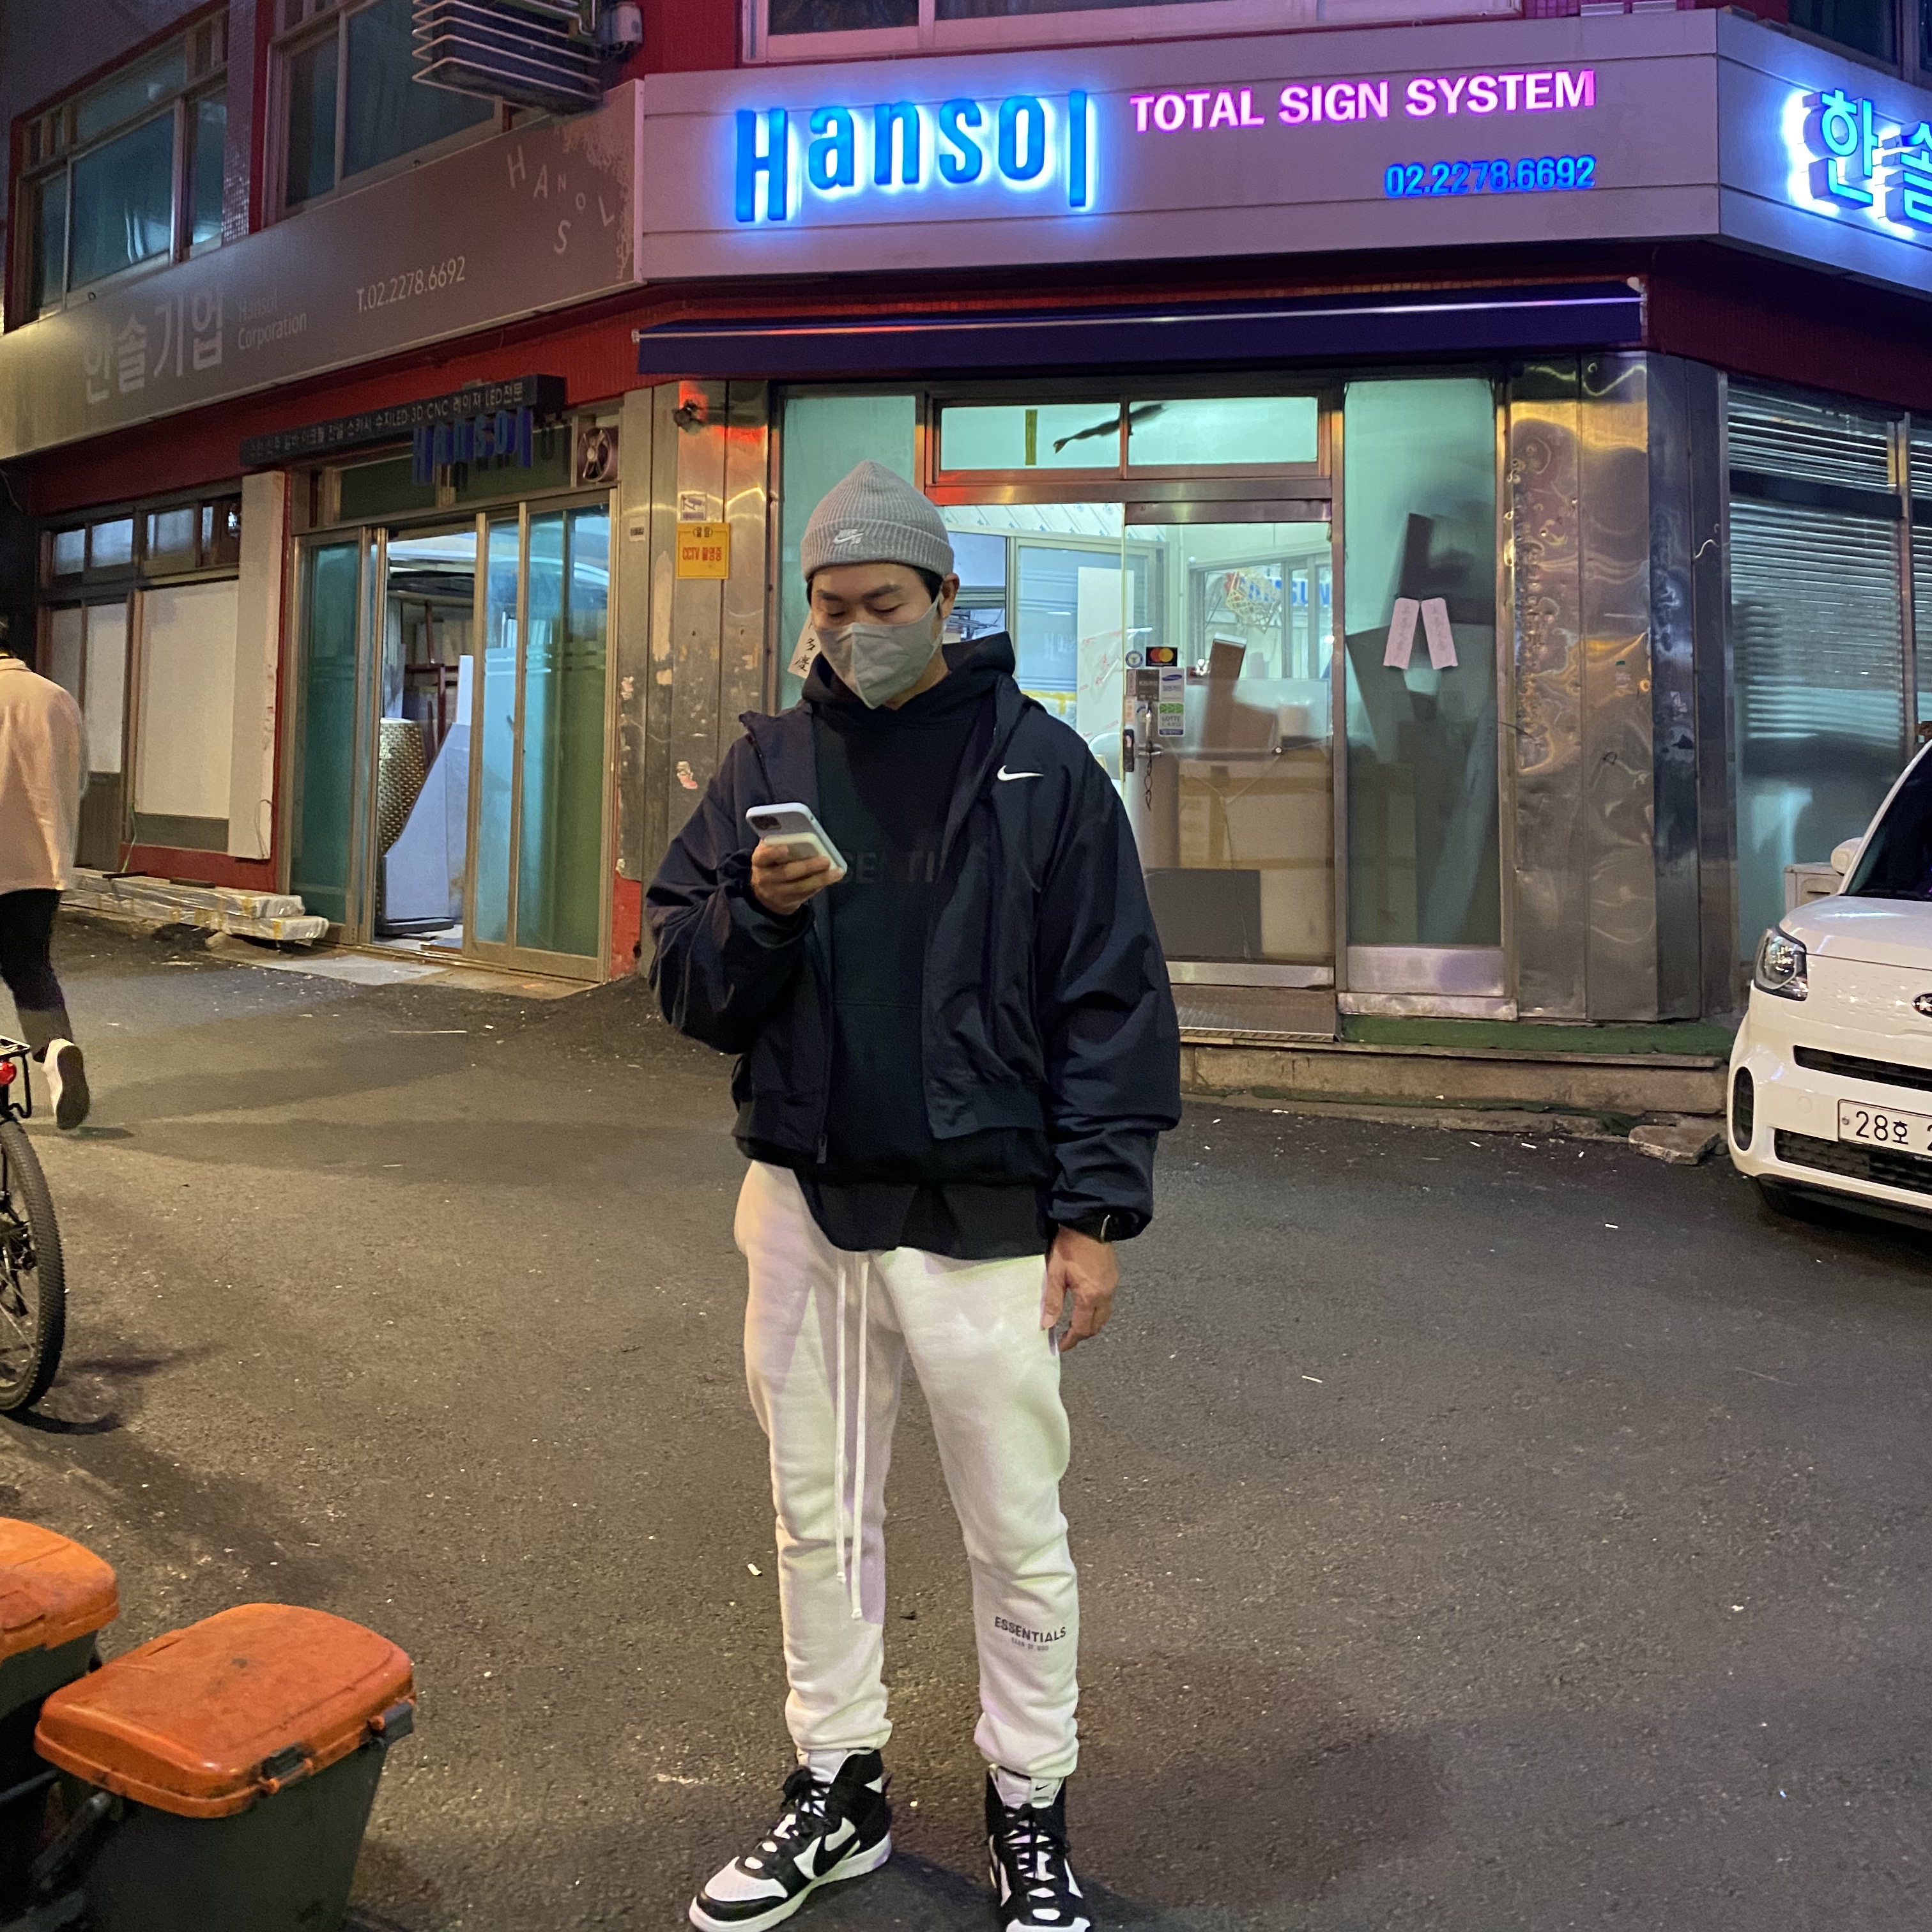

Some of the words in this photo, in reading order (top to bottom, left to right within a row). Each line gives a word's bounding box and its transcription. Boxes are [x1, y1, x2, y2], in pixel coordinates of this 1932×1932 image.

[1130, 89, 1264, 132] TOTAL
[1279, 80, 1389, 124] SIGN
[1406, 70, 1595, 117] SYSTEM
[735, 88, 1087, 222] Hansol
[1384, 155, 1596, 198] 02.2278.6692
[356, 256, 466, 314] T.02.2278.6692
[238, 312, 307, 351] Corporation
[427, 398, 448, 420] CNC
[683, 547, 700, 560] CCTV
[1855, 1110, 1909, 1145] 28호
[994, 1616, 1066, 1643] ESSENTIALS
